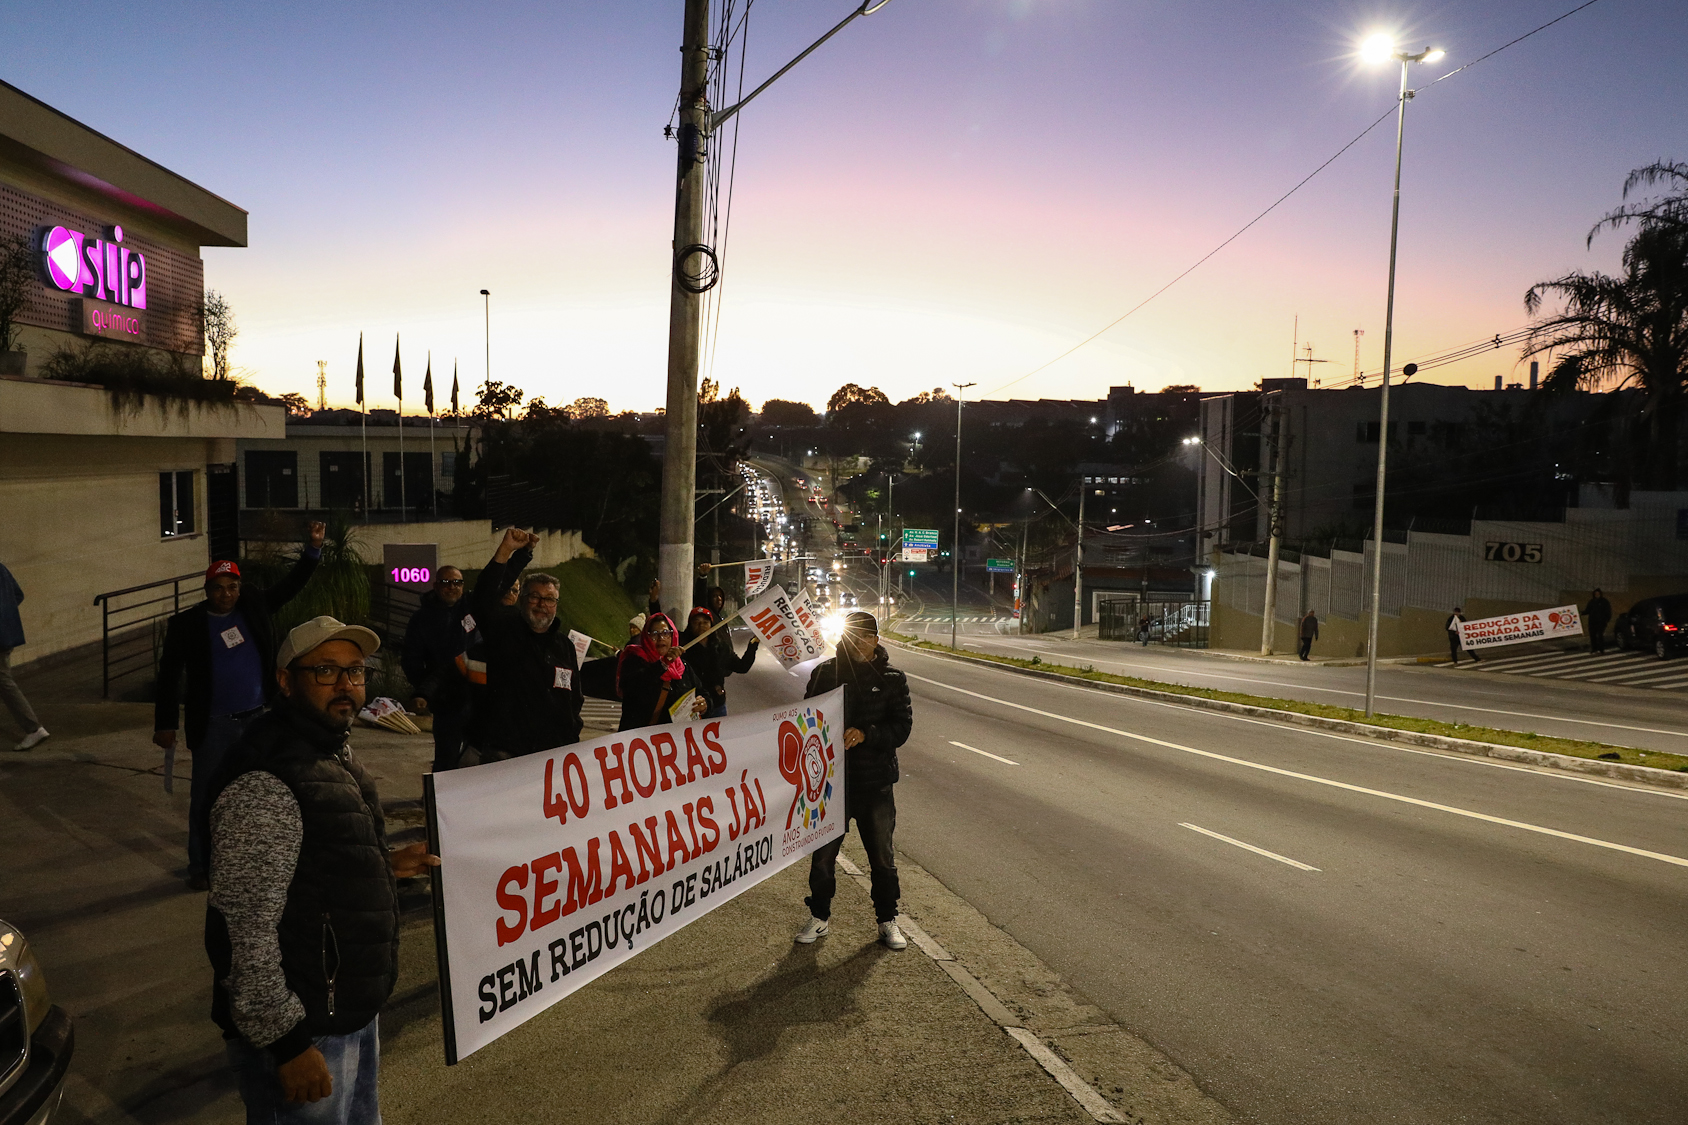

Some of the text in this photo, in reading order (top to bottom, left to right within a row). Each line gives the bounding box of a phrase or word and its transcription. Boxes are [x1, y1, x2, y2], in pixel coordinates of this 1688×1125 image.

[1486, 542, 1542, 563] 705
[391, 567, 430, 583] 1060
[749, 606, 787, 641] JÁ!
[774, 596, 815, 655] REDUÇÃO
[1463, 614, 1540, 632] REDUÇÃO DA
[1464, 621, 1543, 640] JORNADA JÁ!
[1476, 637, 1502, 646] HORAS
[1504, 630, 1545, 642] SEMANAIS
[772, 708, 798, 722] RUMO AOS
[543, 721, 728, 826] 40 HORAS
[782, 826, 801, 847] ANOS
[782, 822, 835, 858] CONSTRUINDO O FUTURO
[495, 769, 768, 948] SEMANAIS JÁ!
[478, 833, 774, 1024] SEM REDUÇÃO DE SALÁRIO!
